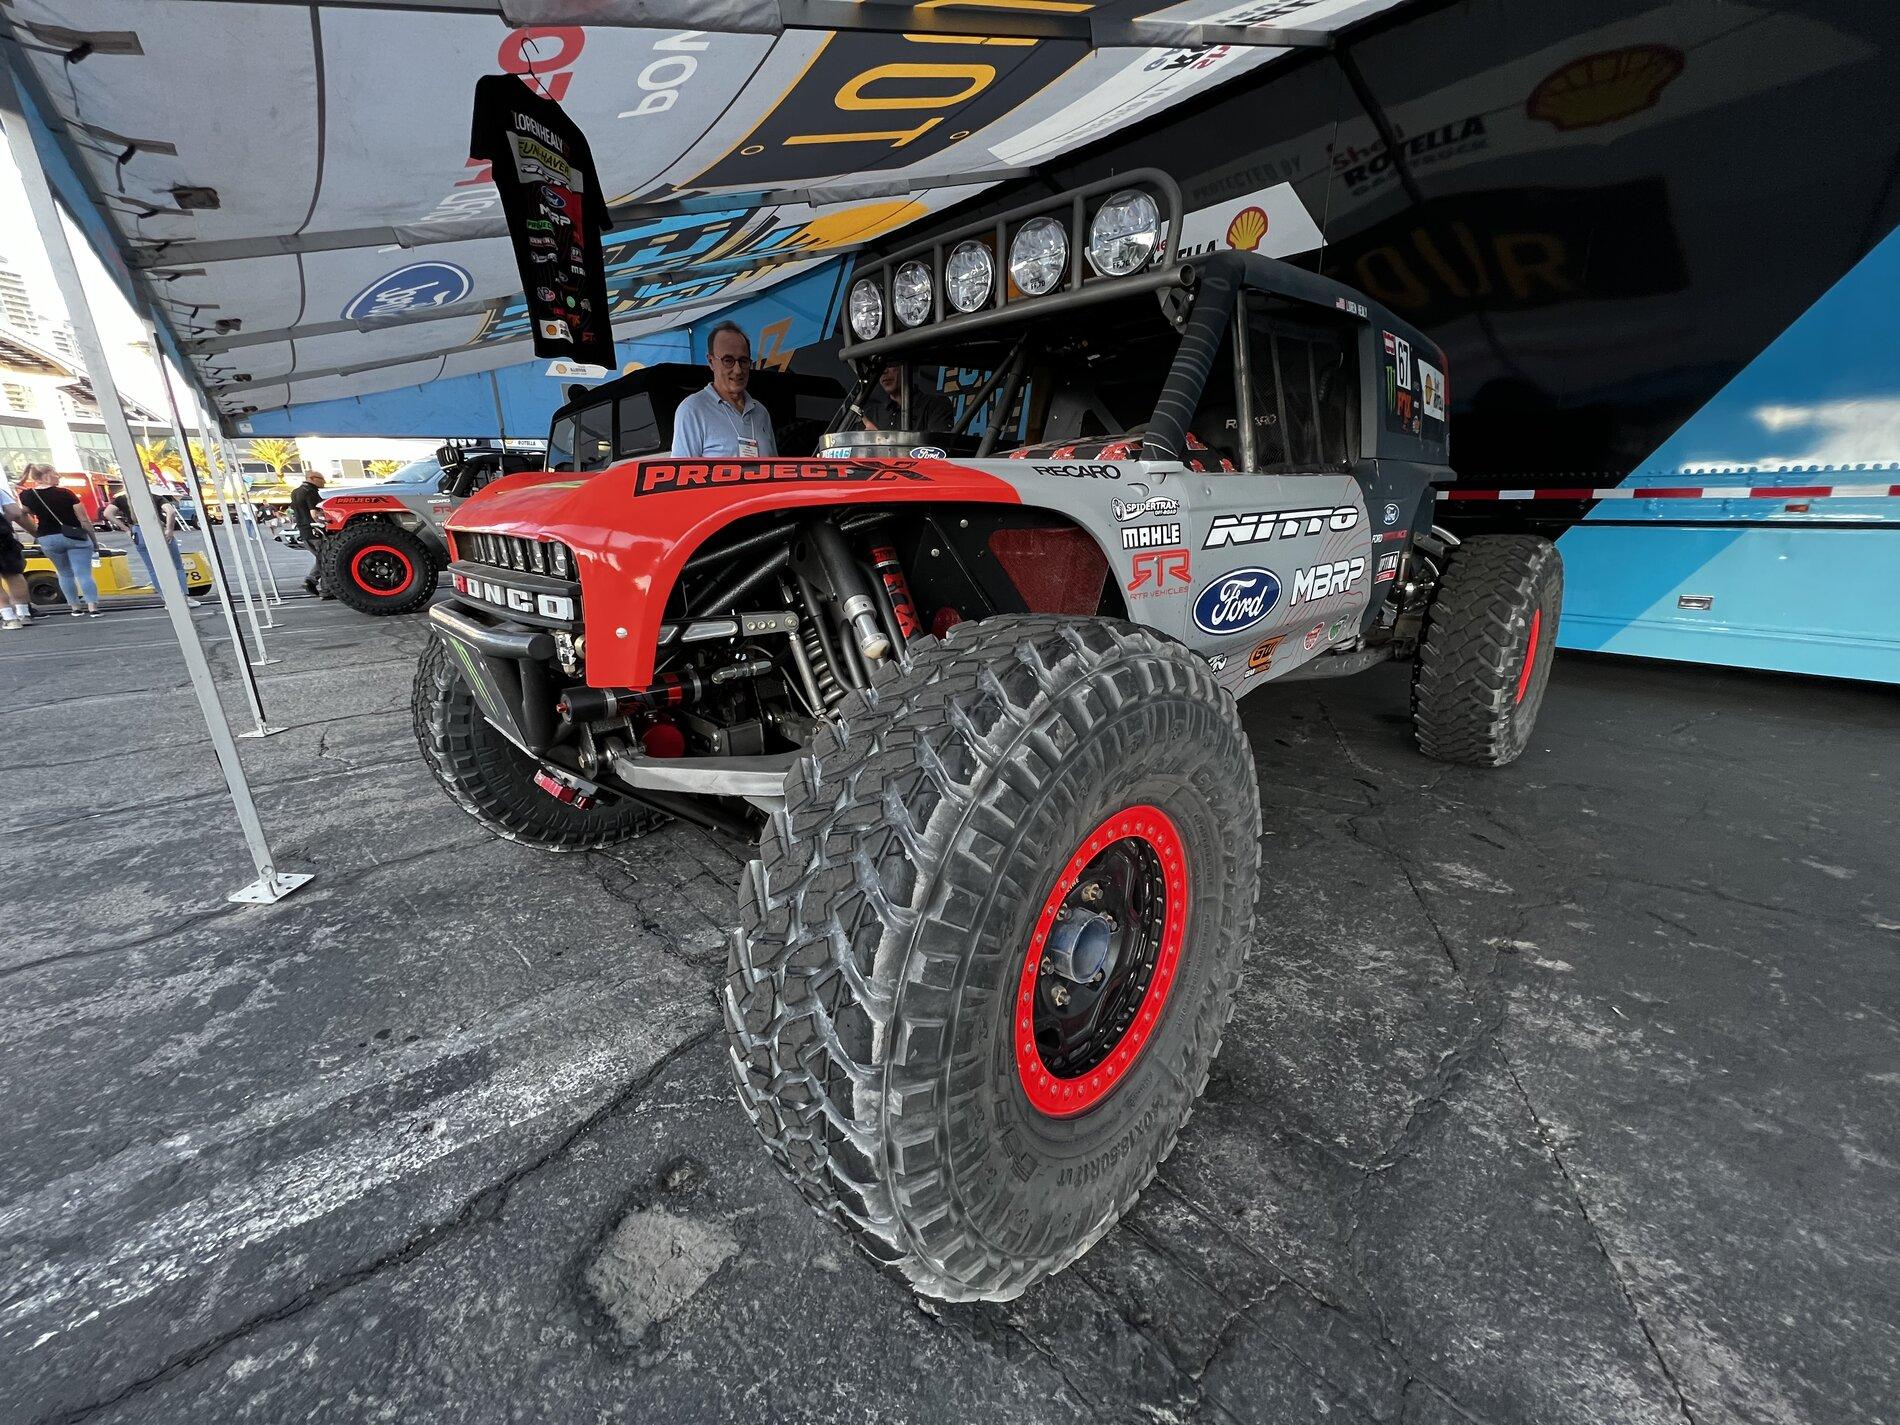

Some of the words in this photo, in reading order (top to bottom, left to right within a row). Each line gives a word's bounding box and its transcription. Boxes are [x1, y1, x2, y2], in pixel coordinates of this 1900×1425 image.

[1398, 340, 1409, 387] 67
[917, 447, 941, 459] Ford
[643, 463, 848, 491] PROJECT
[1032, 465, 1121, 480] RECARO
[1126, 500, 1180, 512] SPIDERTRAX
[1121, 524, 1180, 549] MAHLE
[1201, 506, 1359, 550] NITTO
[452, 572, 575, 621] RONCO
[1290, 556, 1366, 607] MBRP
[1211, 577, 1268, 626] Ford
